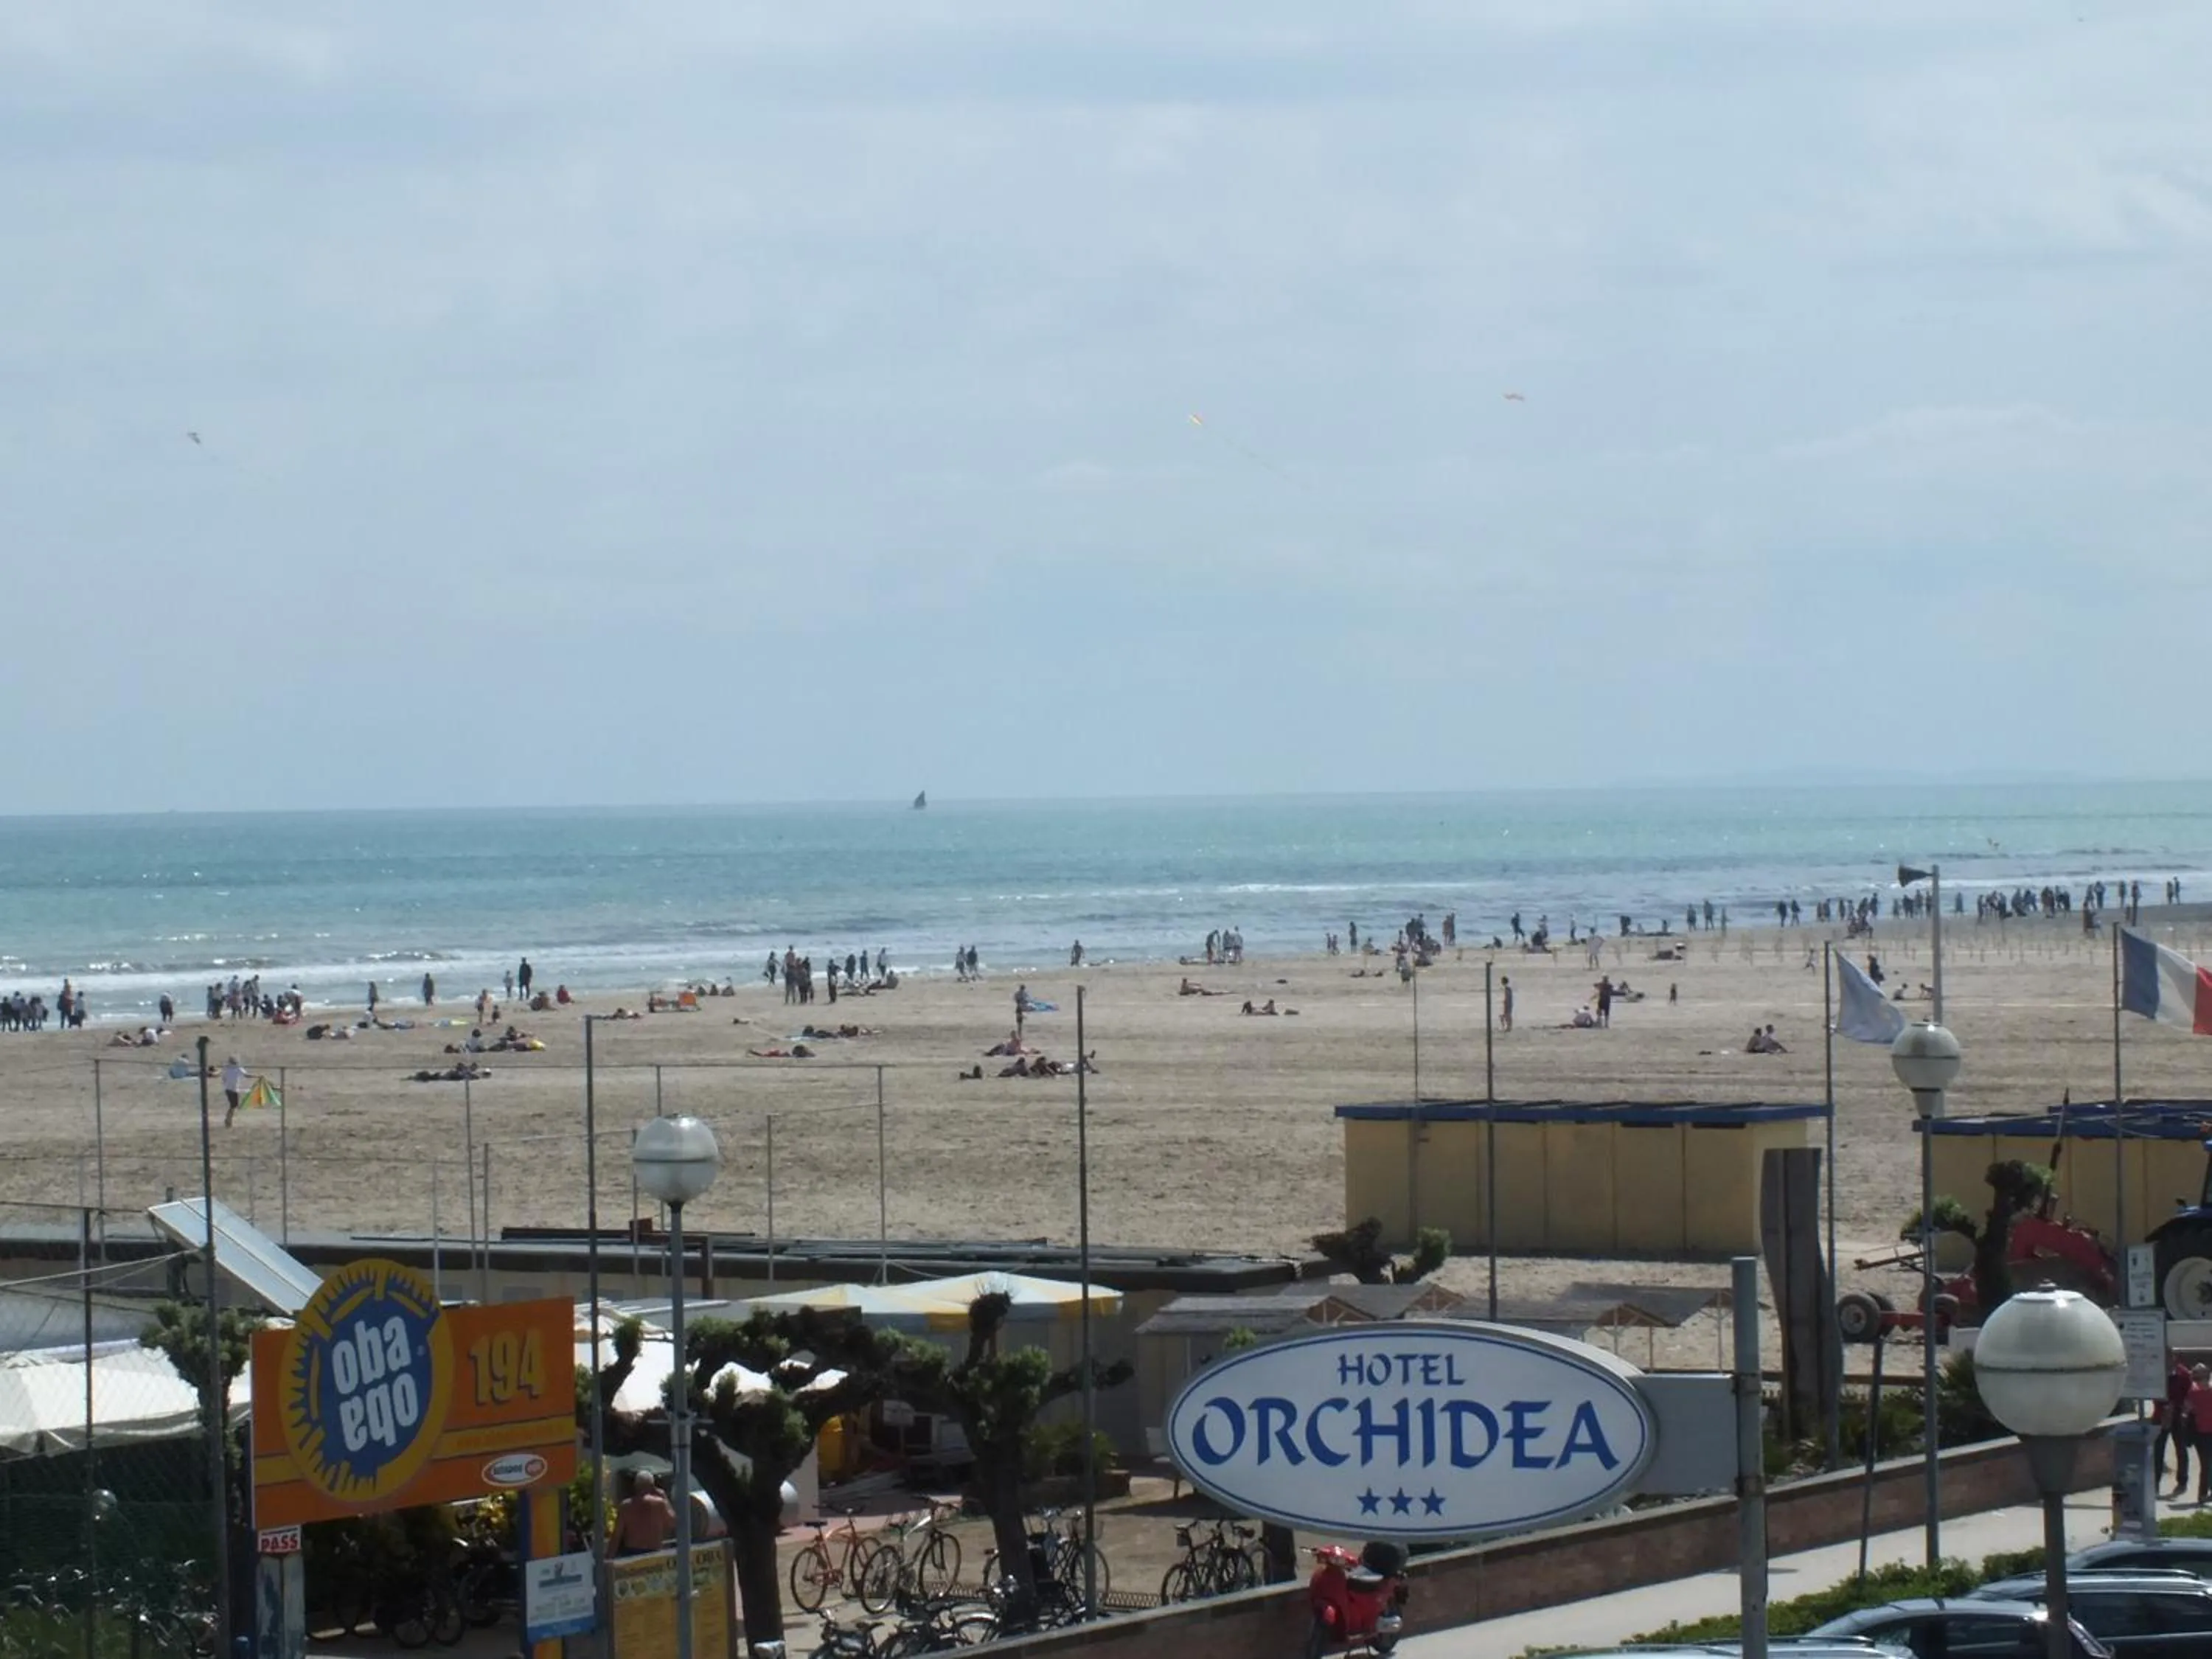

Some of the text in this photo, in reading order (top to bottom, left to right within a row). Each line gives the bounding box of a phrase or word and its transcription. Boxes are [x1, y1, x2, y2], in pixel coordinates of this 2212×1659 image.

[333, 1315, 412, 1394] oba
[468, 1329, 545, 1407] 194
[1338, 1353, 1467, 1386] HOTEL
[1191, 1397, 1620, 1471] ORCHIDEA
[260, 1534, 299, 1552] PASS
